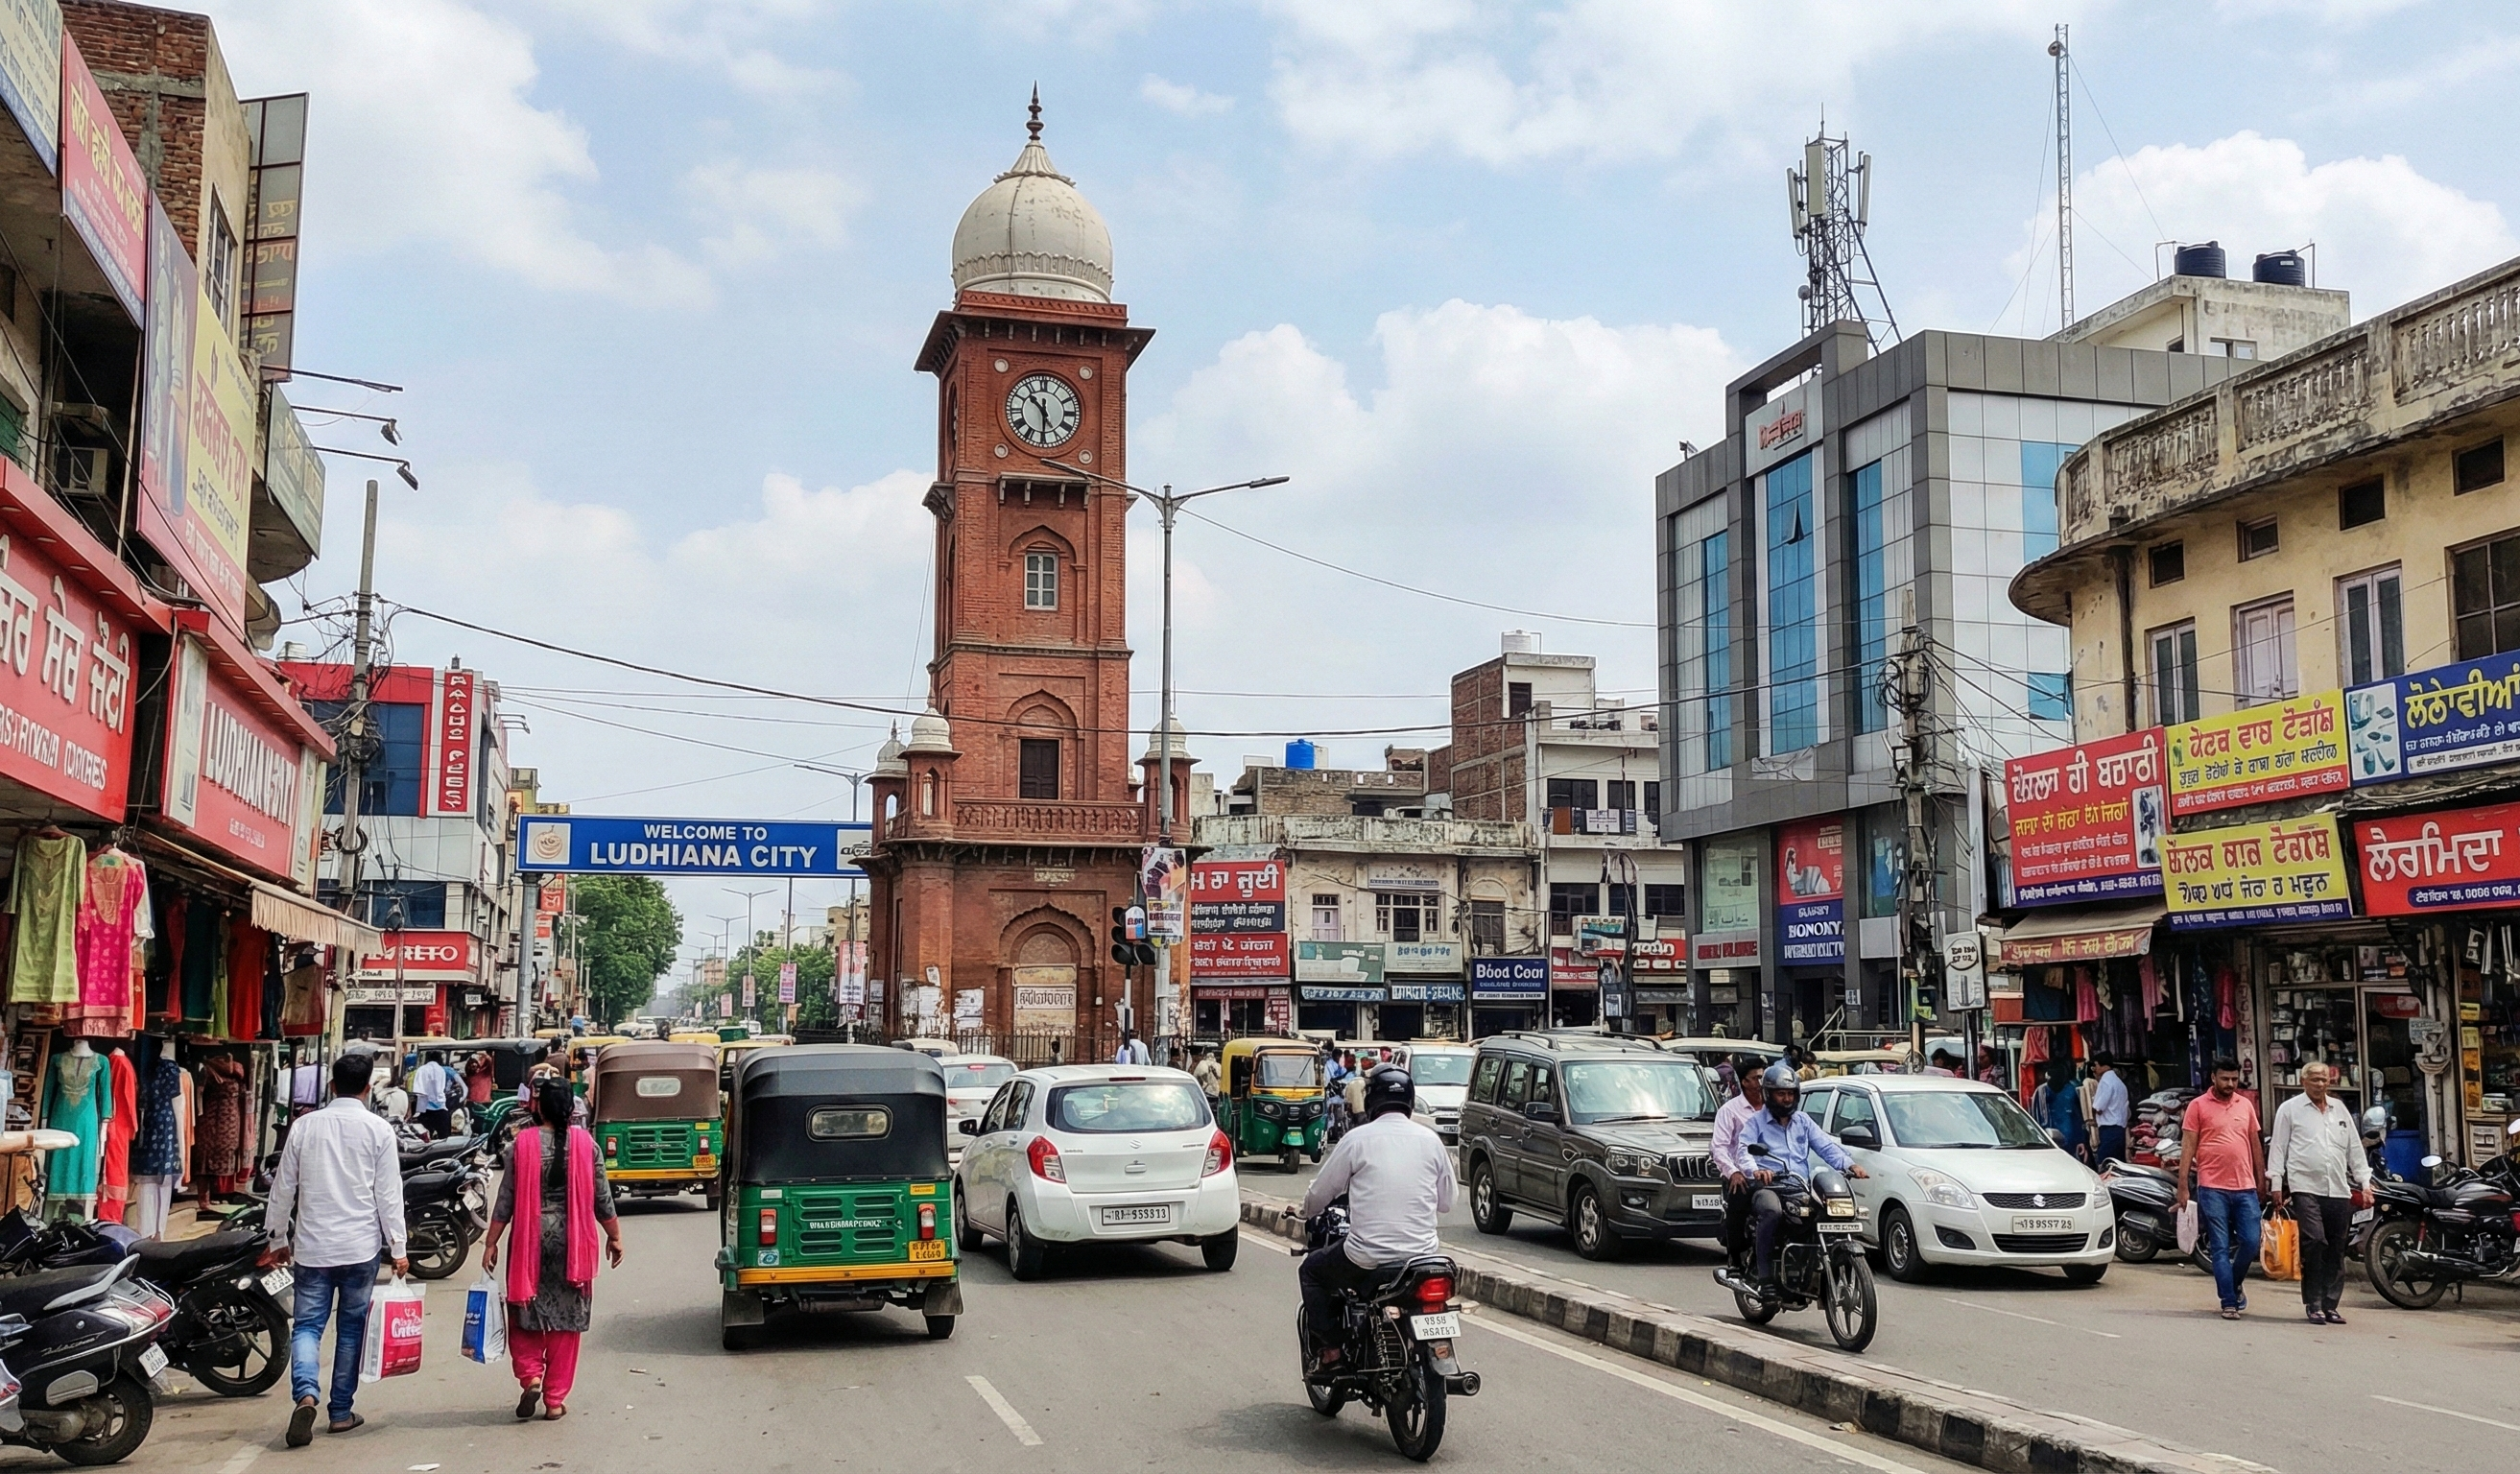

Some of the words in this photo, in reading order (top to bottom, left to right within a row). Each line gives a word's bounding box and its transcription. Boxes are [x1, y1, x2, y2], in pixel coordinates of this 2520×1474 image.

[644, 823, 737, 841] WELCOME
[743, 826, 768, 841] TO
[590, 842, 742, 868] LUDHIANA
[750, 844, 818, 868] CITY
